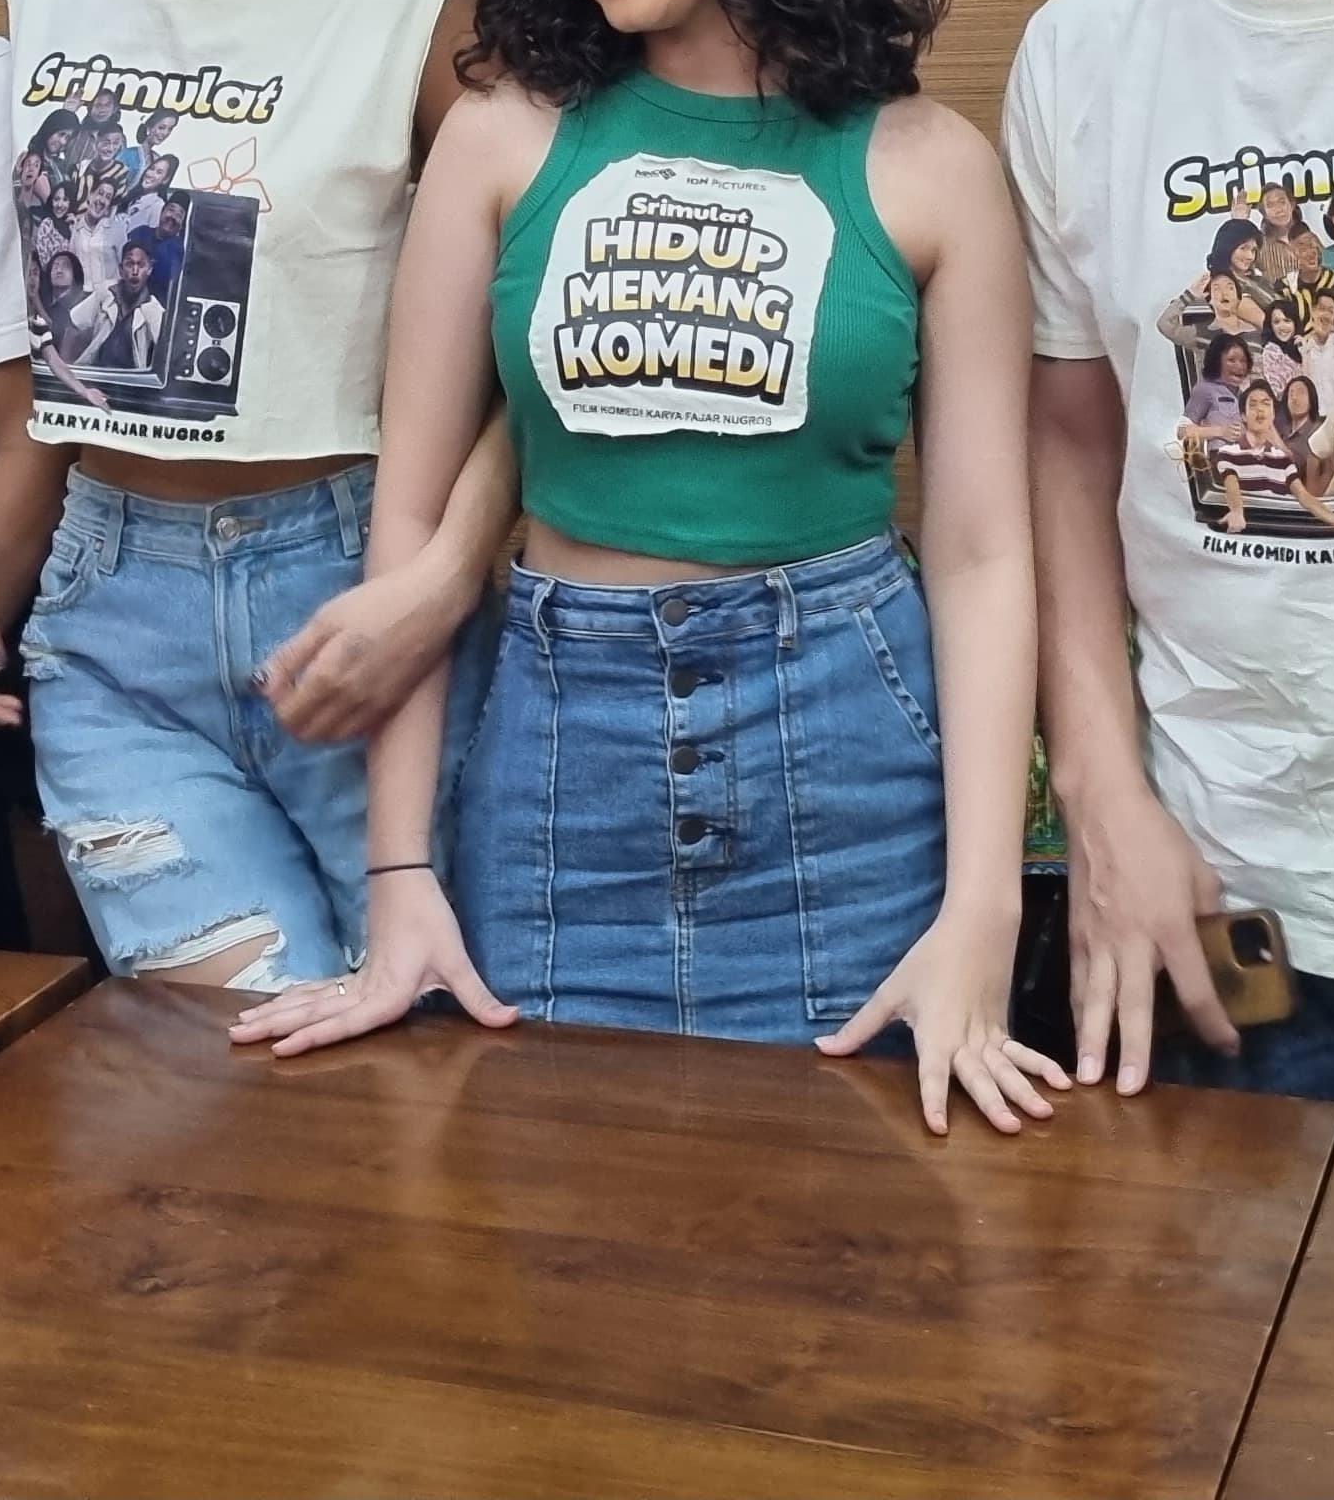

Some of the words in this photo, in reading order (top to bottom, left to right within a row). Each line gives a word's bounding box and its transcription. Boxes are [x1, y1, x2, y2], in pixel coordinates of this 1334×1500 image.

[22, 52, 282, 123] Srimulat
[631, 196, 750, 225] Srimulat
[589, 219, 785, 274] HIDUP
[568, 270, 792, 332] MEMANG
[557, 320, 789, 395] KOMEDI
[42, 411, 101, 431] KARYA
[105, 419, 148, 437] FAJAR
[1203, 535, 1238, 556] FILM
[1242, 543, 1300, 564] KOMEDI
